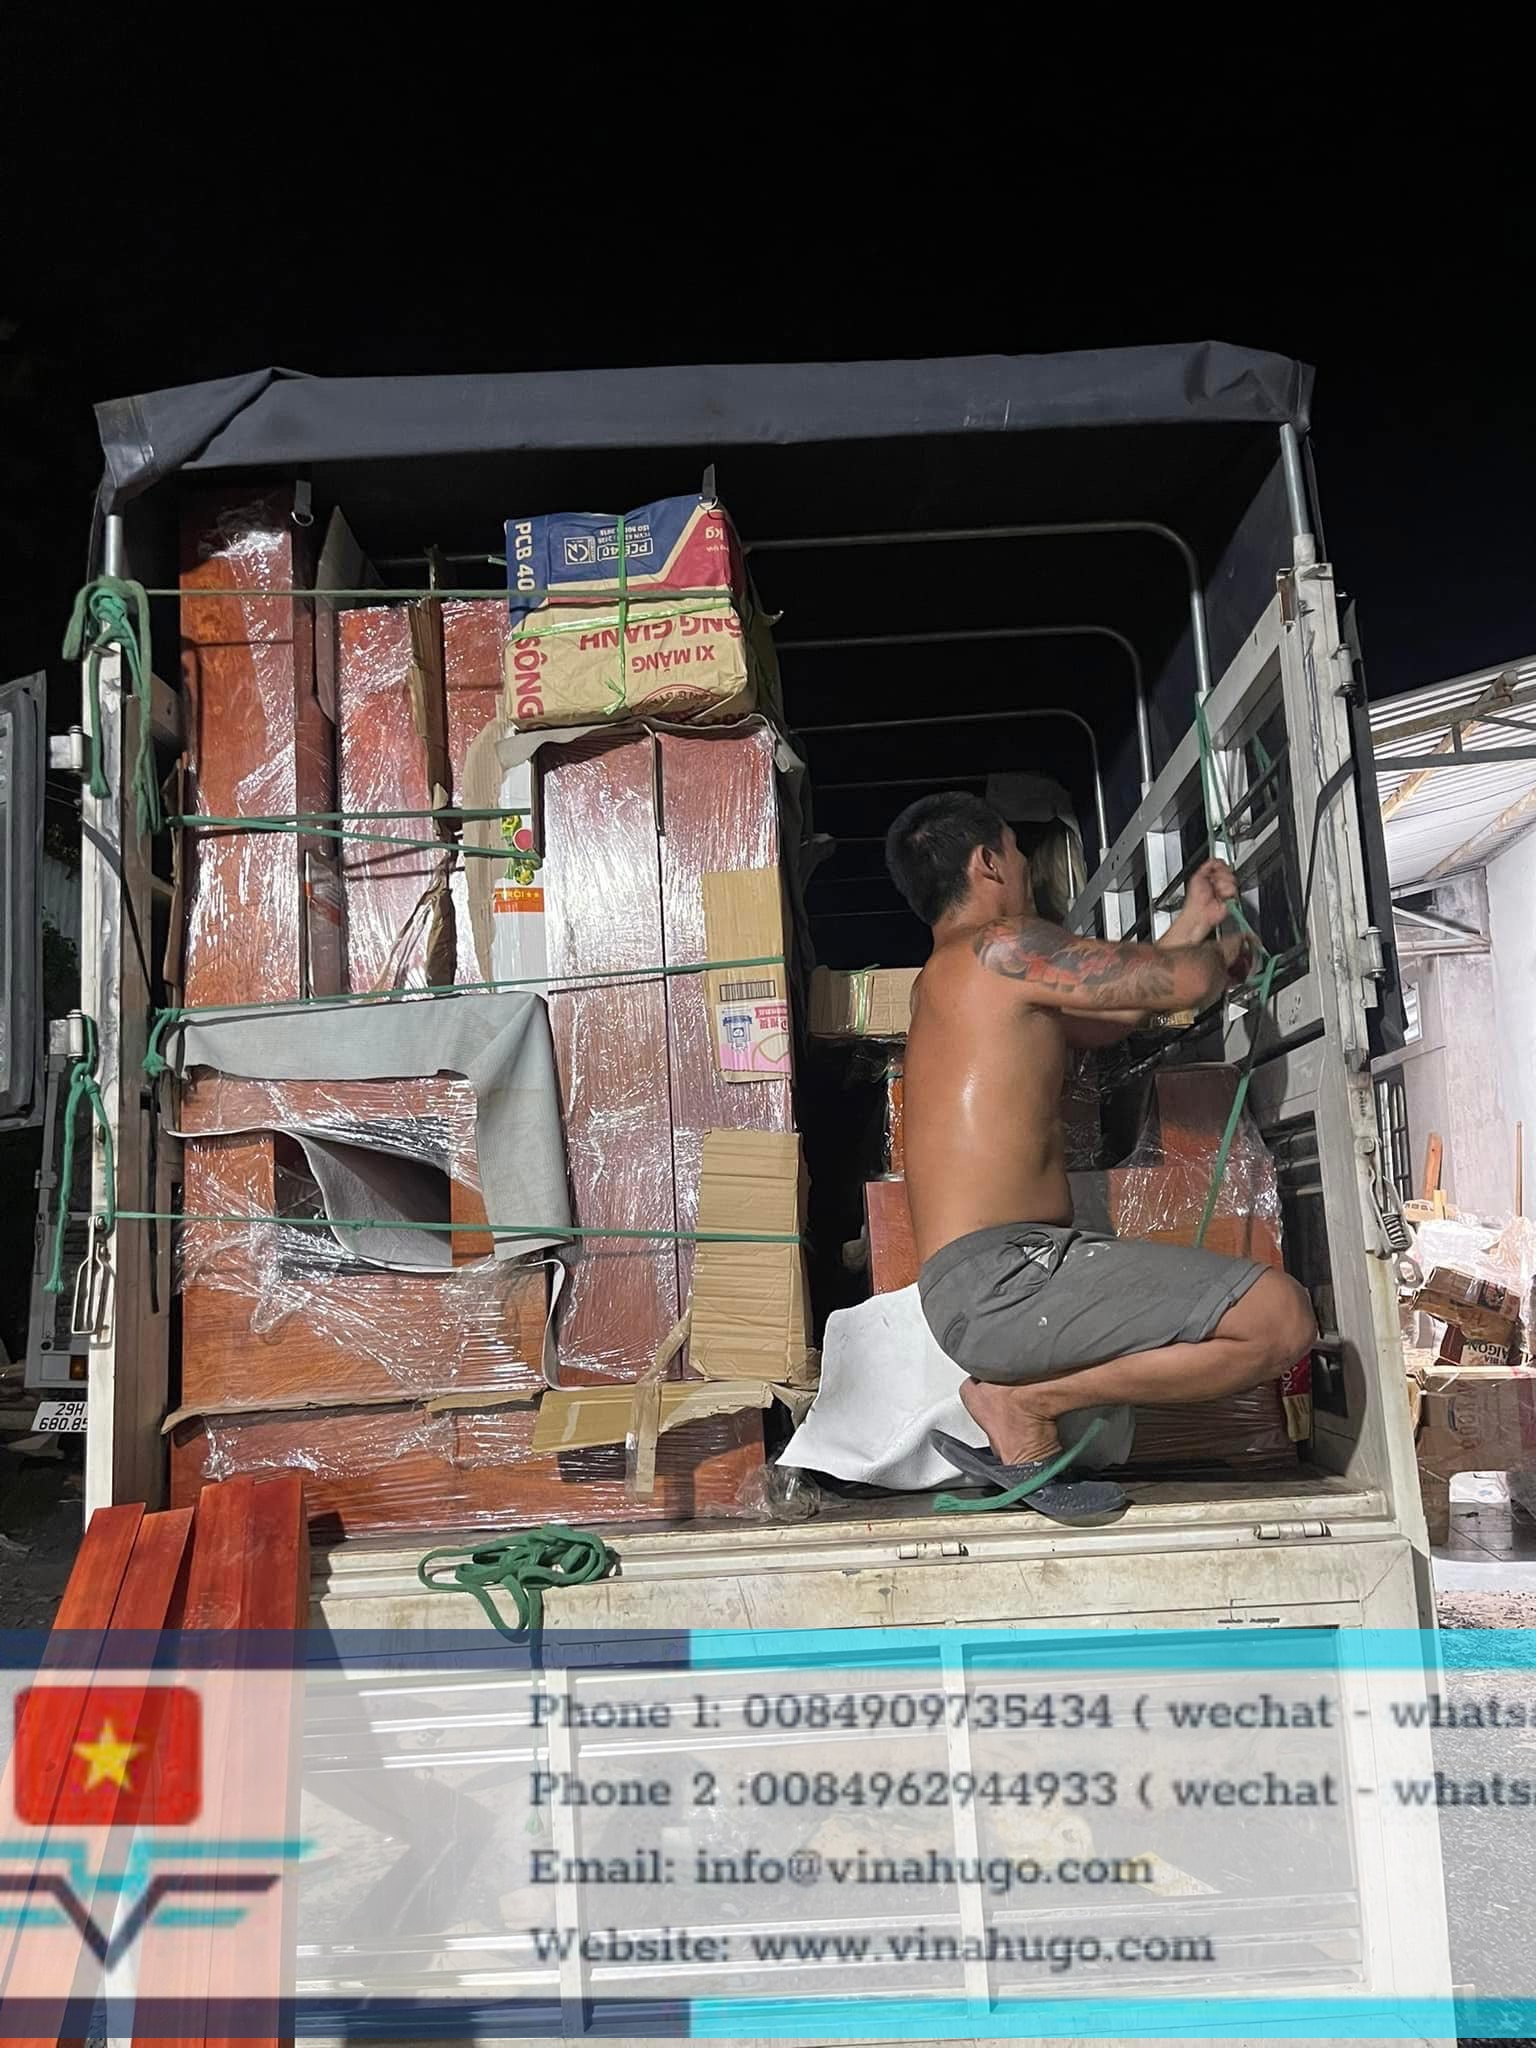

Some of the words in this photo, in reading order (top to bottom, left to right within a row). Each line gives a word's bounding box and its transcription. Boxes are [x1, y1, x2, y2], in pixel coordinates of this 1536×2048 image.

[515, 521, 533, 560] PCB
[705, 526, 724, 541] kg
[517, 564, 536, 591] 40
[579, 619, 673, 651] GIANH
[631, 647, 691, 674] MĂNG
[695, 644, 716, 662] XI
[513, 637, 548, 720] SÔNG
[55, 1403, 86, 1416] 29H
[39, 1417, 88, 1431] 680.85
